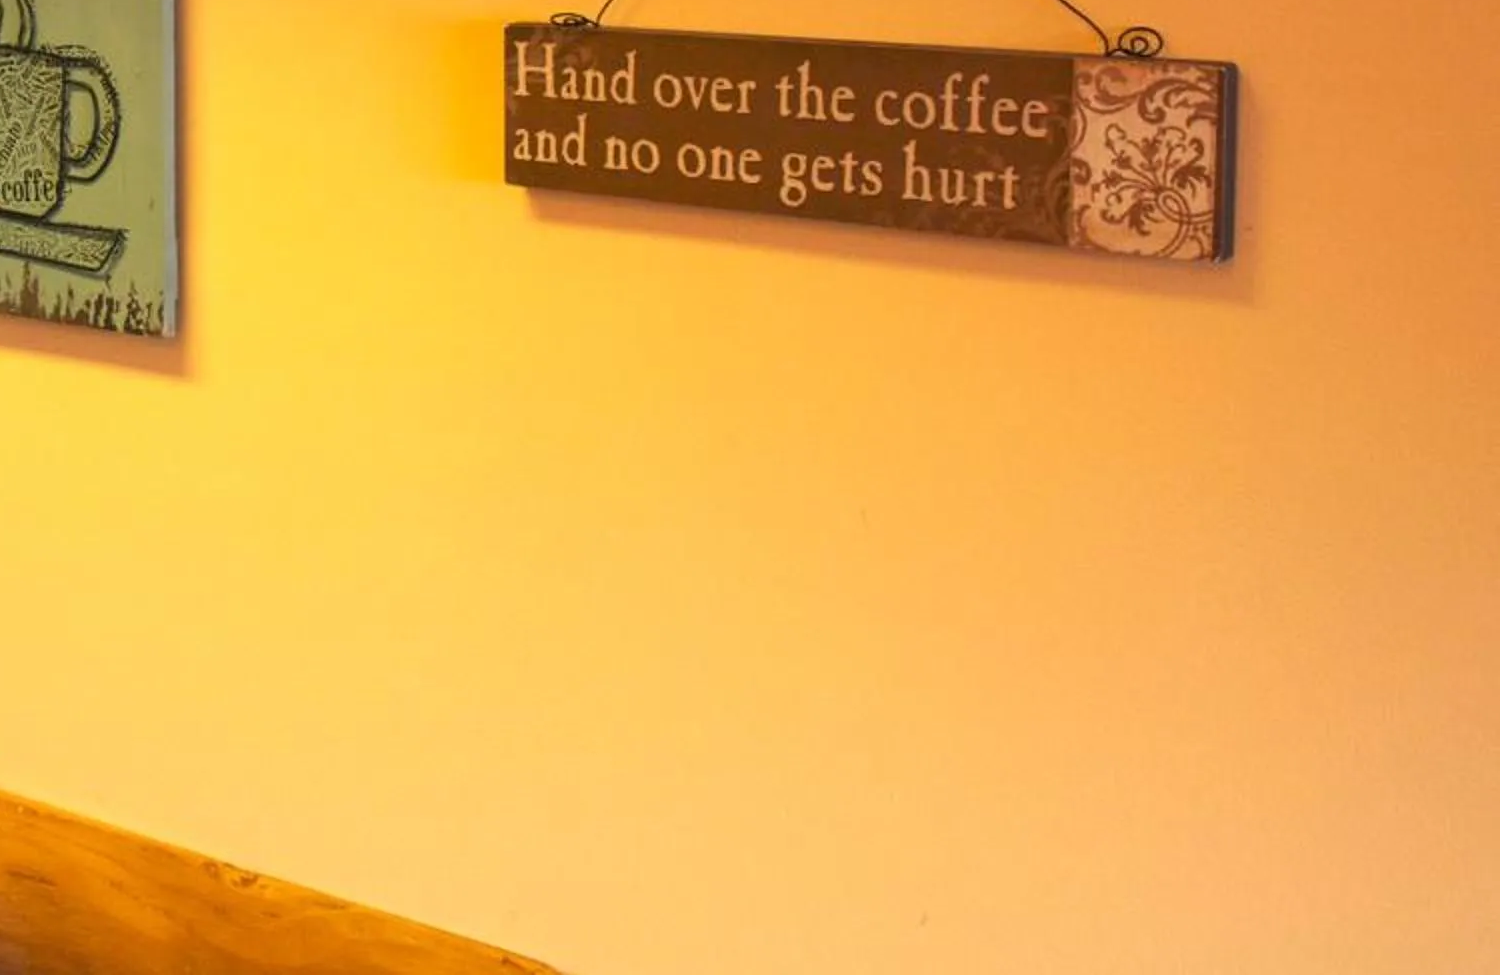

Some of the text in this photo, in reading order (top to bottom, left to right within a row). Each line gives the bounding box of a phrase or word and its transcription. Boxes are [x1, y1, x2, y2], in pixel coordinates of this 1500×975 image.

[512, 40, 1049, 138] Hand over the coffee
[0, 168, 55, 205] coffe
[512, 113, 1020, 210] and no one gets hurt
